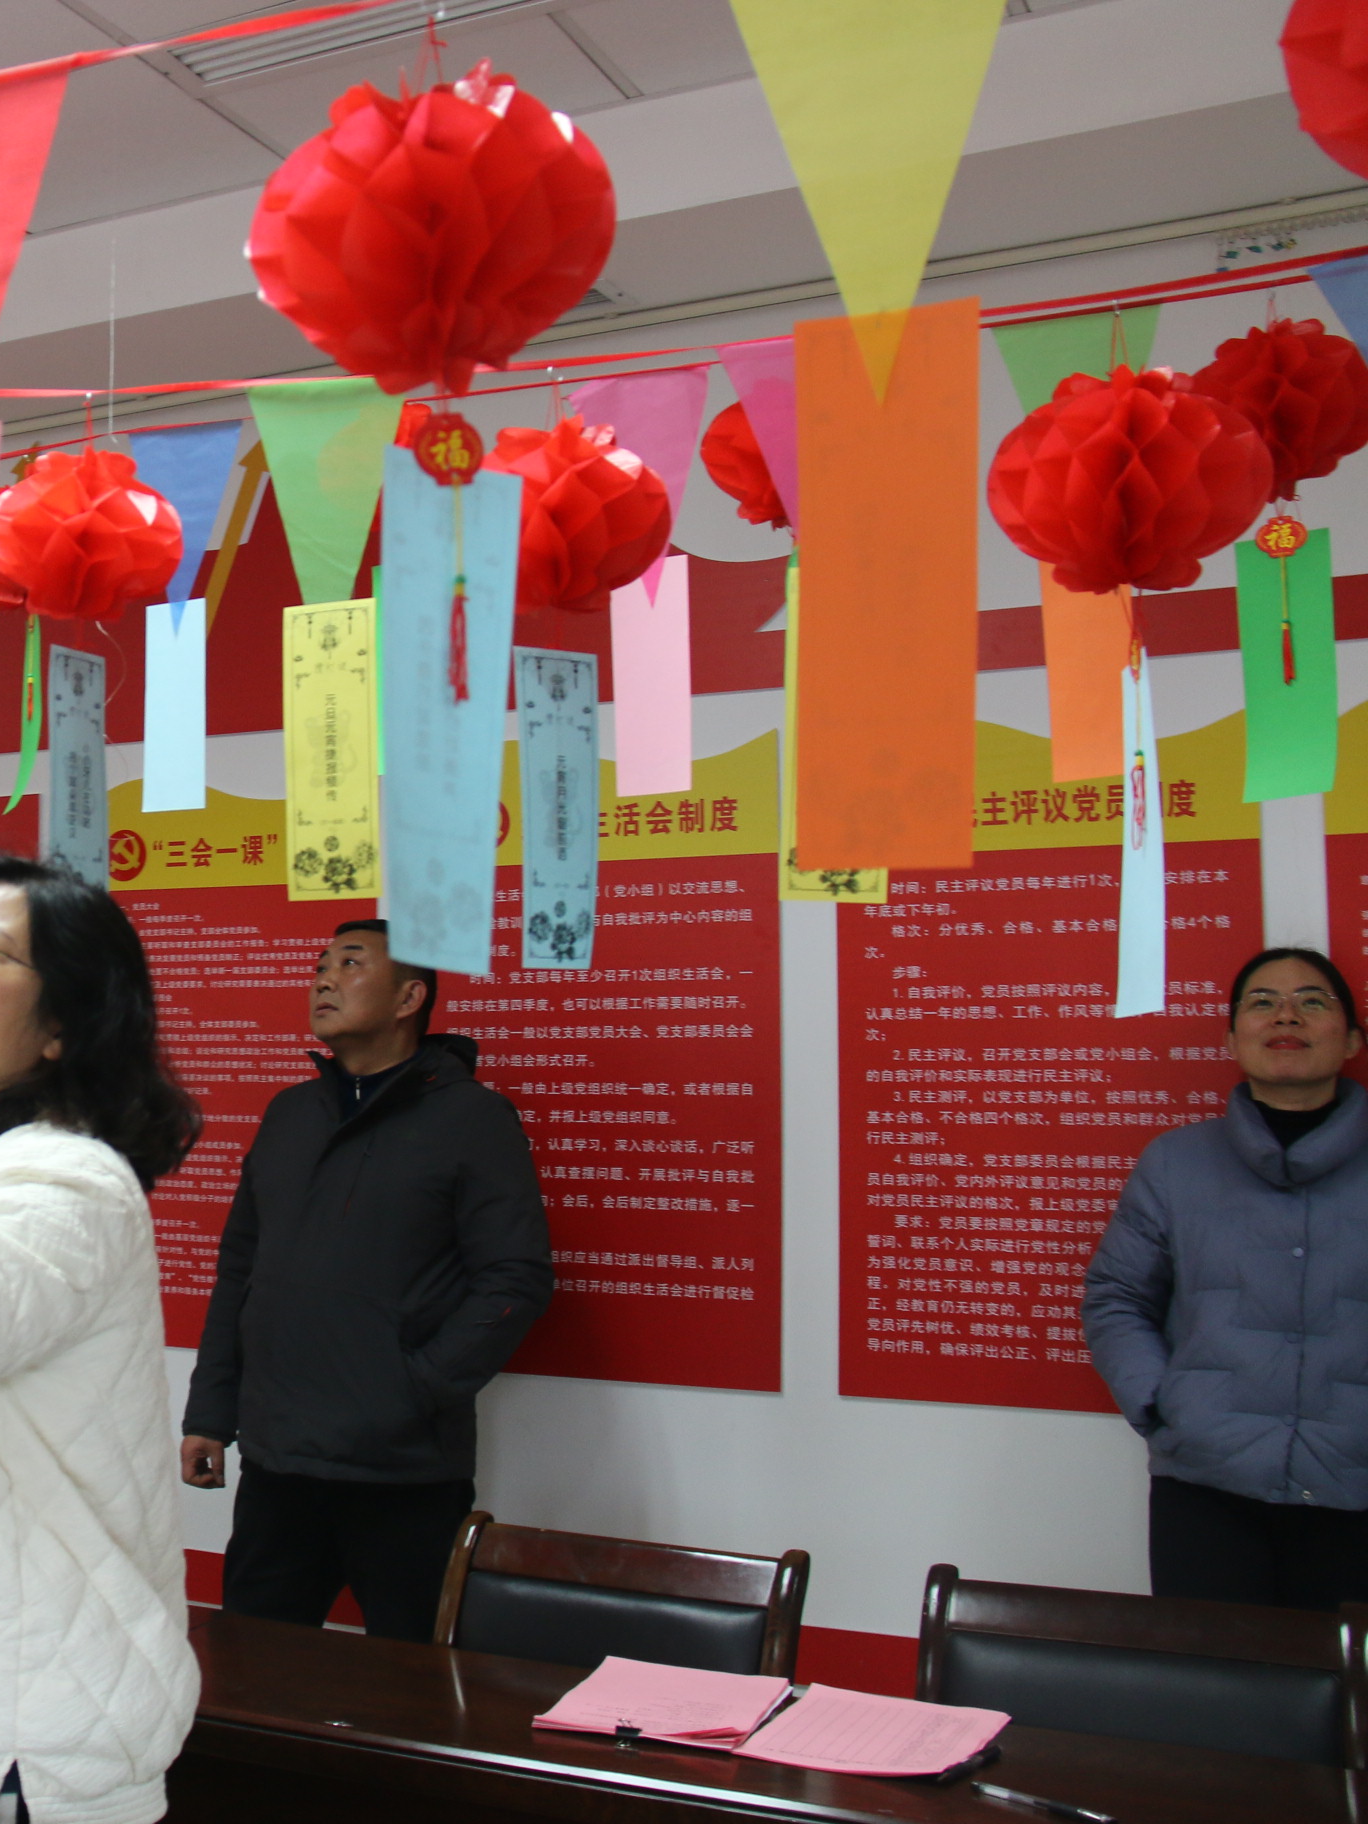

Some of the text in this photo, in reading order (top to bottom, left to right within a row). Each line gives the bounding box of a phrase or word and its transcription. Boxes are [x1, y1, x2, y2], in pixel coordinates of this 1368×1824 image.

[431, 429, 470, 471] 福
[1264, 523, 1296, 551] 福
[866, 1131, 946, 1146] 行民主测评；
